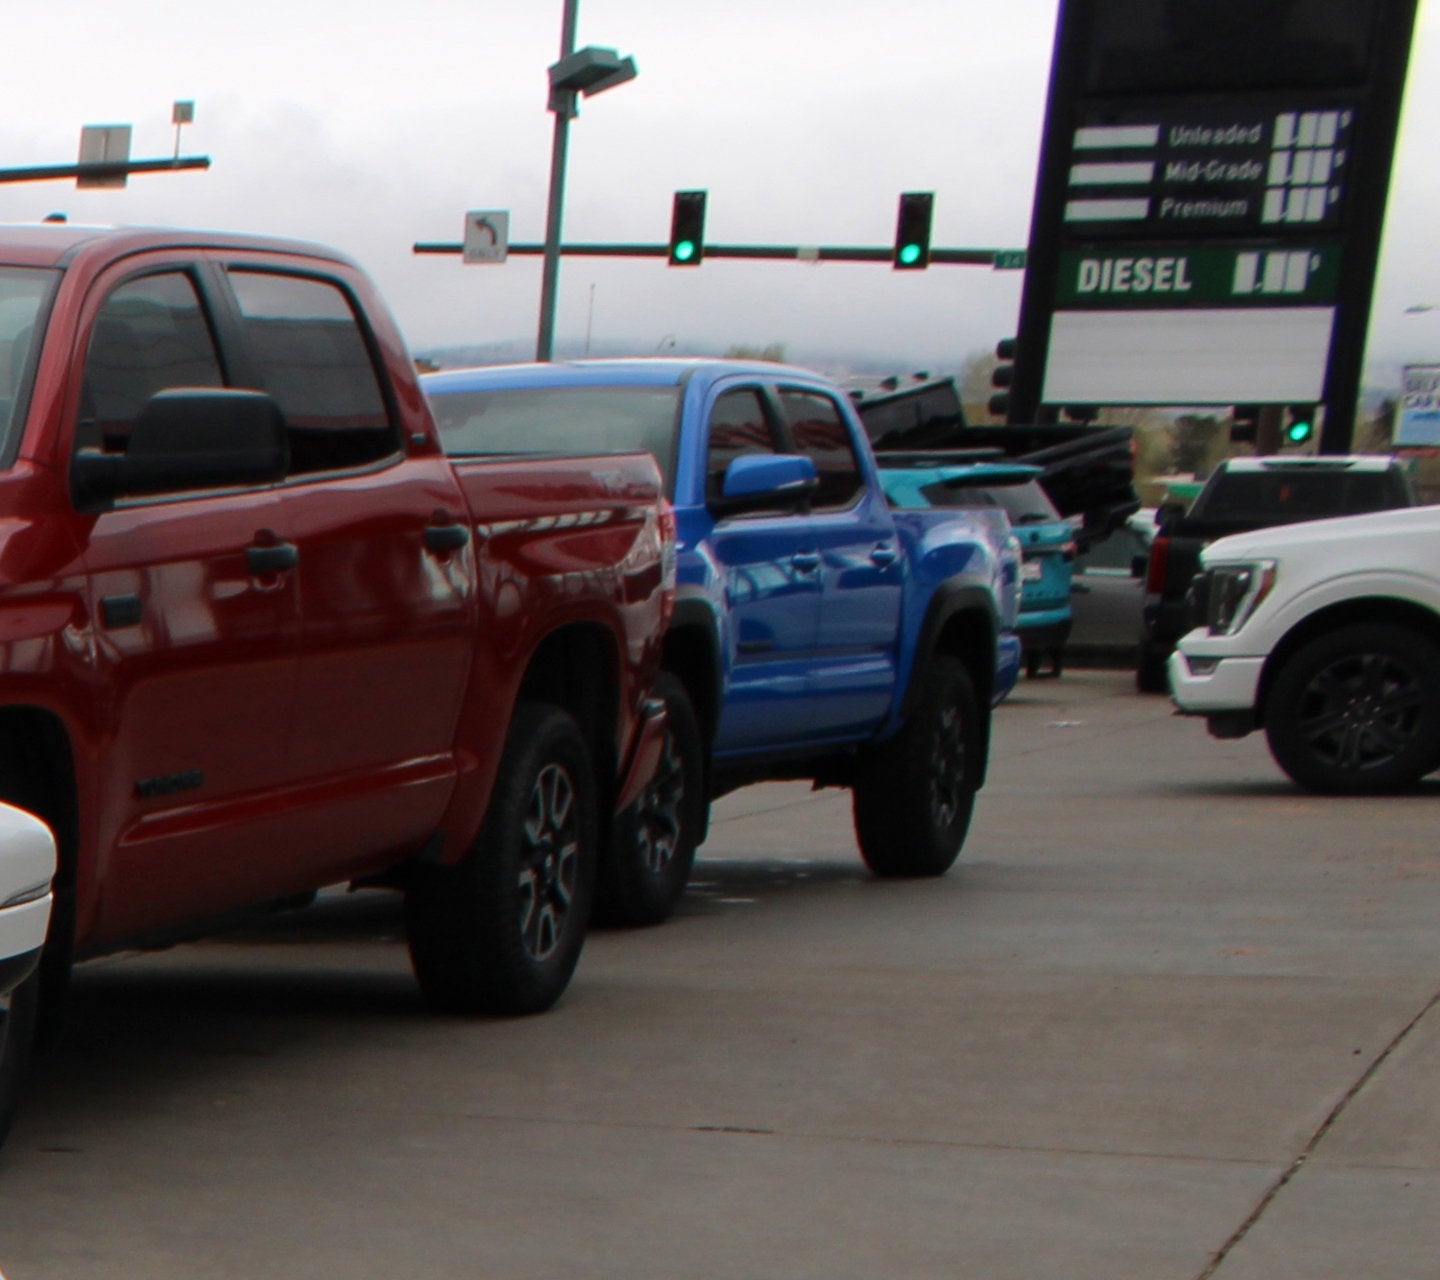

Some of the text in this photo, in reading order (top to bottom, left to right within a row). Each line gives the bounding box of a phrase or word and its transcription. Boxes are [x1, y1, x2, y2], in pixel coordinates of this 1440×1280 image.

[1169, 123, 1262, 149] Unleaded
[1164, 159, 1263, 182] Mid-Grade
[1159, 198, 1249, 219] Premium
[1076, 256, 1193, 293] DIESEL
